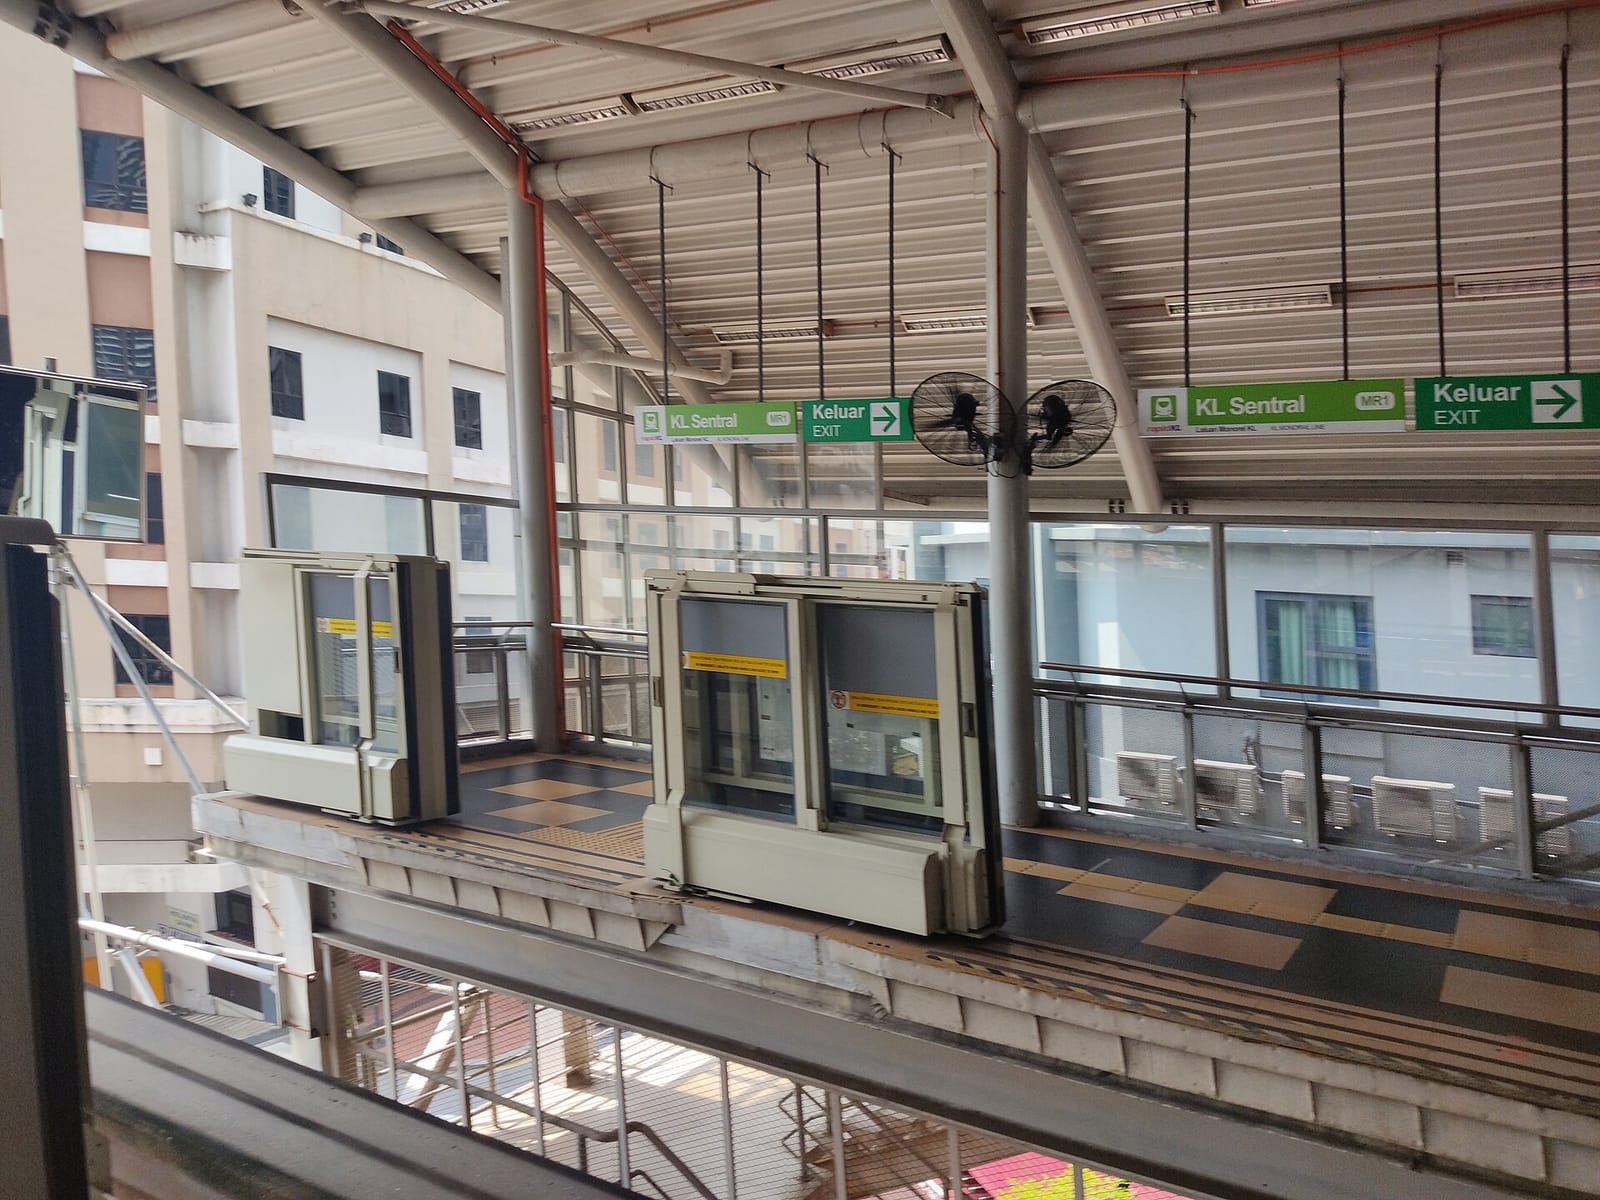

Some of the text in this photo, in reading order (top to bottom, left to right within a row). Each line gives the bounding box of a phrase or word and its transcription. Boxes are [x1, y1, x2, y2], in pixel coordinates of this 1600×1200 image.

[1361, 395, 1391, 407] MR1
[1433, 383, 1522, 403] Keluar
[812, 404, 866, 420] Keluar
[1195, 395, 1305, 416] KL Sentral
[670, 412, 738, 429] KL Sentral
[1434, 409, 1481, 425] EXIT
[812, 424, 841, 438] EXIT
